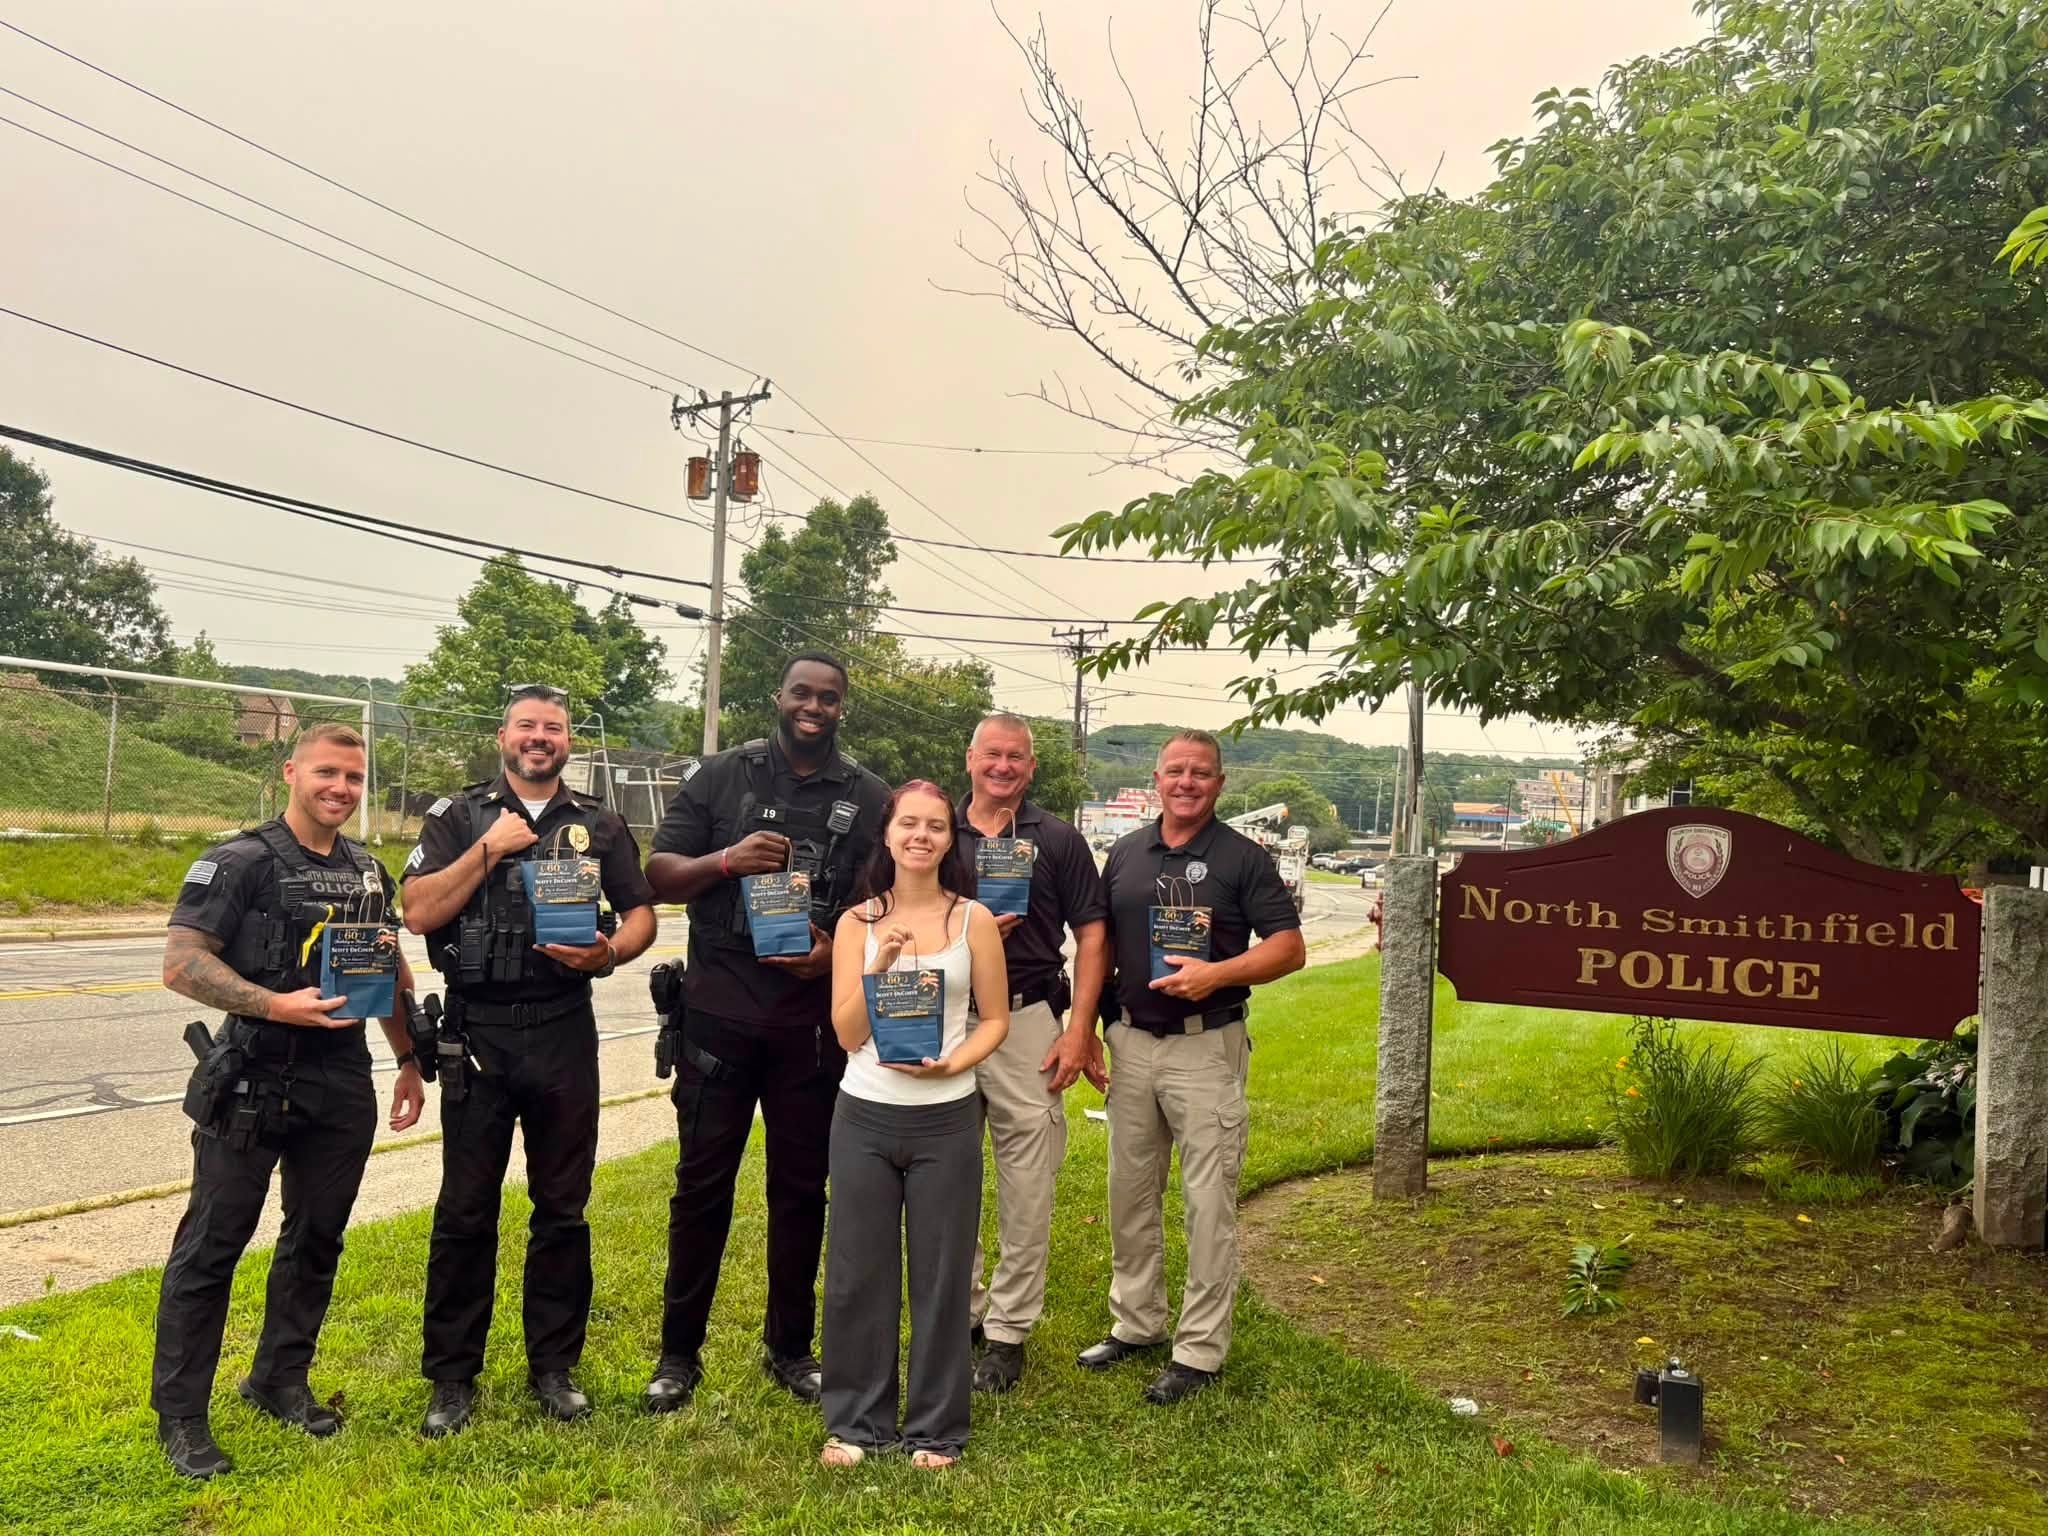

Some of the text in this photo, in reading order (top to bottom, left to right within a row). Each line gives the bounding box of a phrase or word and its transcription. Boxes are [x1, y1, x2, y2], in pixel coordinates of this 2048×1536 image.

[762, 808, 776, 819] 19
[1458, 884, 1959, 950] North Smithfield
[344, 931, 358, 941] 60
[1576, 947, 1820, 1000] POLICE
[887, 975, 900, 985] 60
